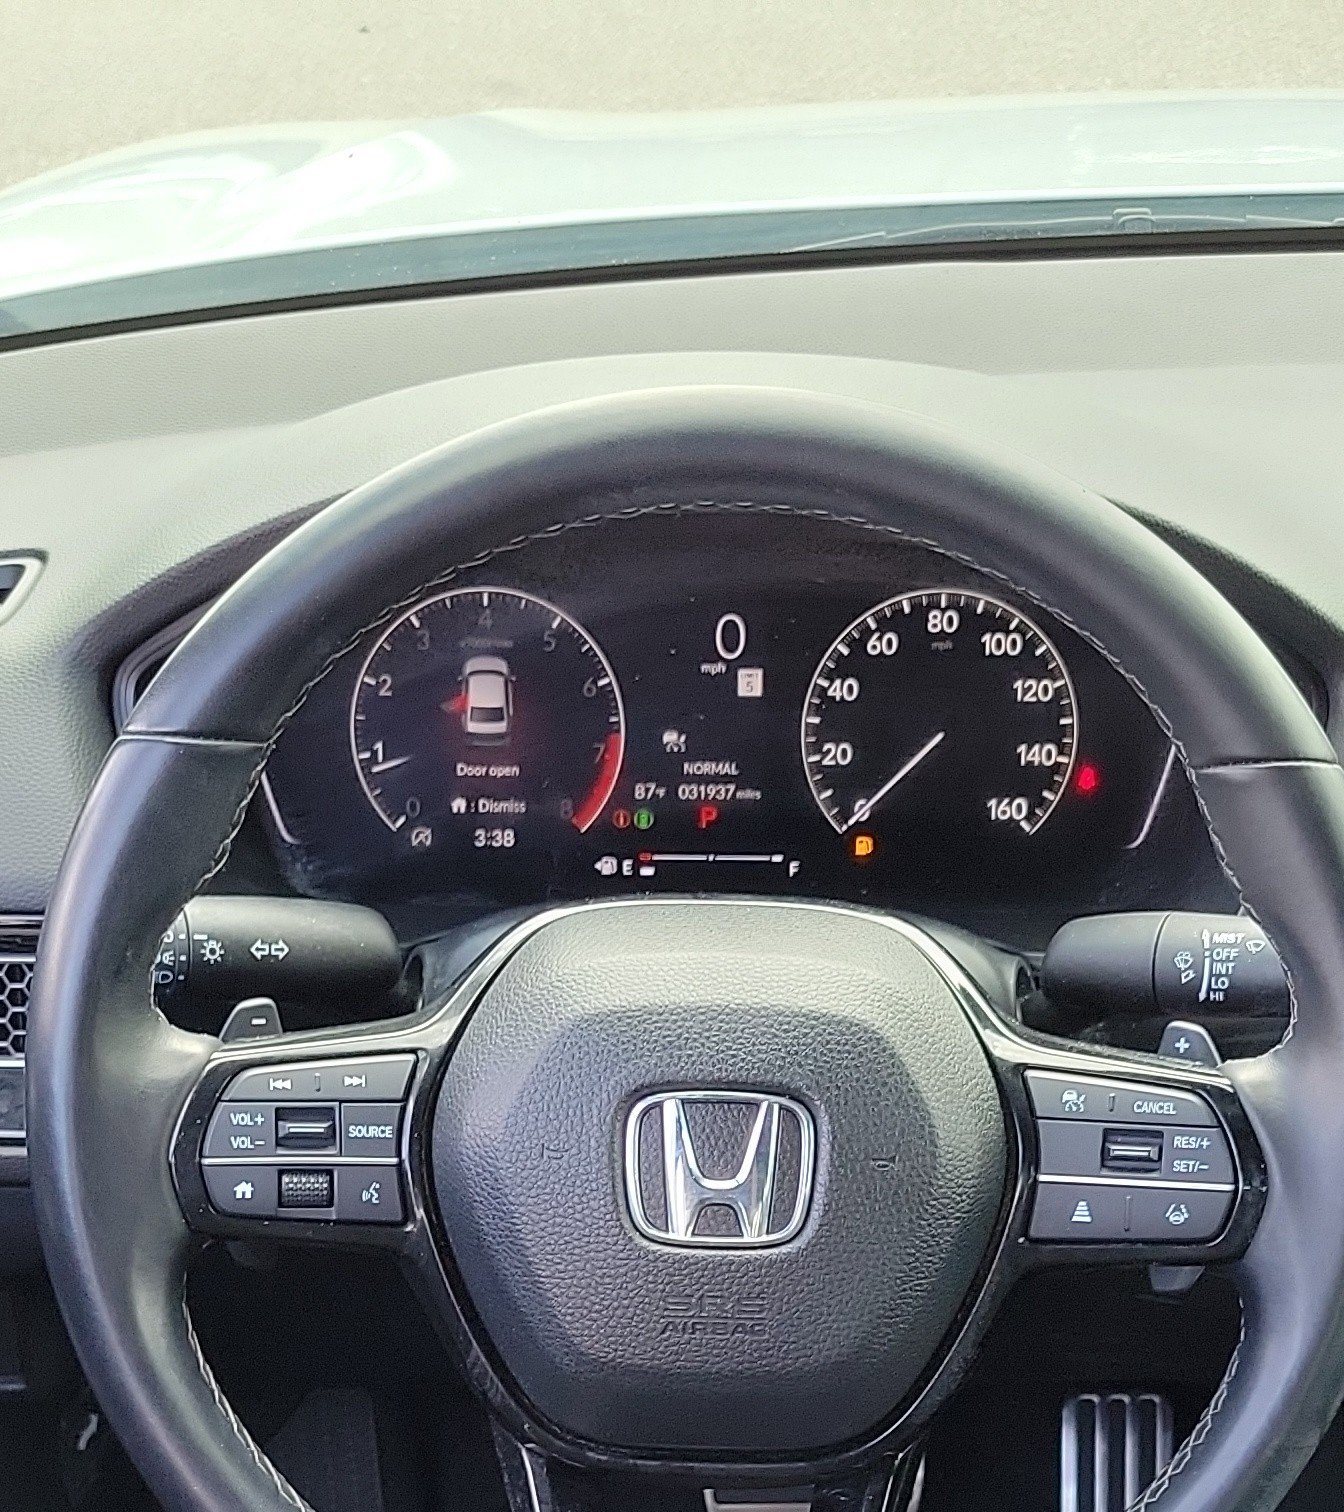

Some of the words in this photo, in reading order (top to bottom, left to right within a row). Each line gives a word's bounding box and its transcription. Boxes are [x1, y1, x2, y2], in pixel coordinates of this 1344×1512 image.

[478, 611, 491, 628] 4
[927, 609, 960, 634] 80
[417, 631, 430, 650] 3
[543, 632, 556, 650] 5
[716, 613, 746, 660] 0
[867, 632, 899, 656] 60
[981, 632, 1024, 656] 100
[701, 661, 727, 677] mph
[378, 676, 392, 697] 2
[582, 678, 597, 696] 6
[827, 678, 860, 701] 40
[1013, 679, 1054, 703] 120
[372, 741, 384, 761] 1
[593, 744, 606, 762] 7
[821, 743, 853, 766] 20
[1016, 743, 1056, 767] 140
[456, 762, 487, 777] Door
[489, 765, 520, 778] open
[683, 761, 739, 775] NORMAL
[677, 783, 736, 800] 031937
[406, 799, 420, 817] 0
[477, 797, 527, 813] Dismiss
[987, 798, 1028, 821] 160
[698, 806, 717, 828] P
[474, 828, 516, 848] 3:38
[622, 859, 634, 876] E
[789, 860, 801, 878] F
[1212, 932, 1245, 944] MIST
[1213, 948, 1239, 960] OFF
[1213, 962, 1236, 974] INT
[1211, 977, 1229, 989] LO
[1210, 991, 1224, 1001] HI
[1133, 1101, 1177, 1115] CANCEL
[229, 1113, 265, 1126] VOL+
[348, 1126, 393, 1138] SOURCE
[1173, 1137, 1211, 1149] RES/+
